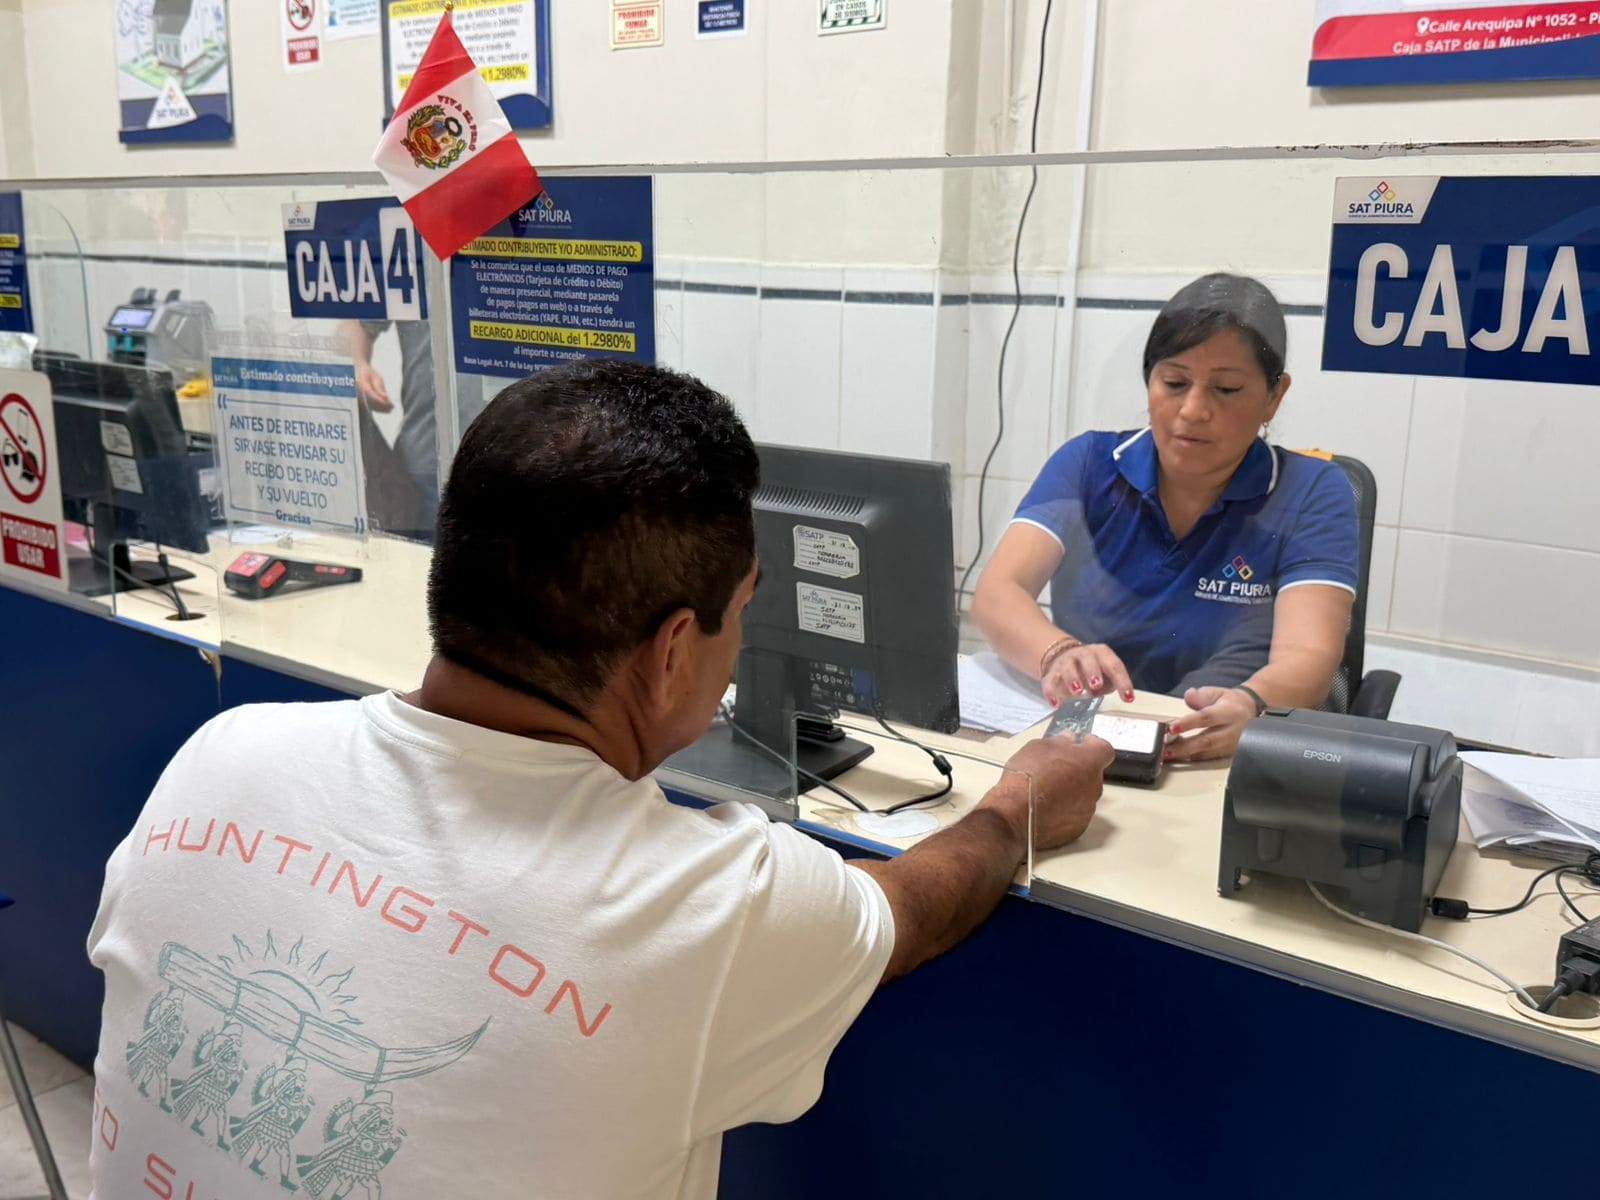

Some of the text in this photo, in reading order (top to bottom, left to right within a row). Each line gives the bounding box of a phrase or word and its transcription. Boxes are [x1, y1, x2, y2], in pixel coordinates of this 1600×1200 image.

[1428, 20, 1461, 33] Calle
[1463, 17, 1523, 33] Arequipa
[1545, 13, 1577, 27] 1052
[1393, 41, 1422, 55] Caja
[1425, 39, 1461, 53] SATP
[1464, 39, 1480, 51] de
[1484, 37, 1500, 50] la
[518, 209, 572, 223] SAT PIURA
[1349, 203, 1414, 214] SAT PIURA
[497, 241, 557, 254] CONTRIBUYENTE
[559, 243, 573, 255] Y/O
[574, 244, 638, 258] ADMINISTRADO:
[296, 228, 415, 304] CAJA 4
[487, 261, 520, 271] comunica
[520, 264, 533, 274] que
[535, 263, 541, 272] el
[542, 264, 555, 273] uso
[556, 264, 565, 273] de
[566, 264, 594, 275] MEDIOS
[596, 265, 606, 275] DE
[607, 266, 628, 277] PAGO
[476, 271, 525, 284] ELECTRÓNICOS
[553, 275, 562, 285] de
[563, 276, 588, 288] Crédito
[480, 284, 489, 294] de
[490, 286, 515, 296] manera
[554, 289, 587, 300] mediante
[588, 291, 619, 303] pasarela
[1354, 242, 1590, 355] CAJA
[486, 296, 495, 306] de
[604, 304, 613, 314] de
[625, 320, 635, 329] un
[473, 325, 631, 350] RECARGO ADICIONAL del 1.2980%
[521, 346, 549, 358] importe
[556, 350, 586, 360] cancelar
[240, 367, 355, 388] Estimado contribuyente
[230, 414, 347, 441] ANTES DE RETIRARSE
[234, 437, 346, 464] SIRVASE REVISAR SU
[245, 460, 338, 487] RECIBO DE PAGO
[257, 484, 328, 510] Y SU VUELTO
[275, 509, 312, 525] Gracias
[2, 517, 56, 550] PROHIBIDO
[16, 543, 45, 569] USAR
[1198, 577, 1271, 597] SAT PIURA
[1303, 749, 1342, 763] EPSON
[143, 817, 612, 1037] HUNTINGTON
